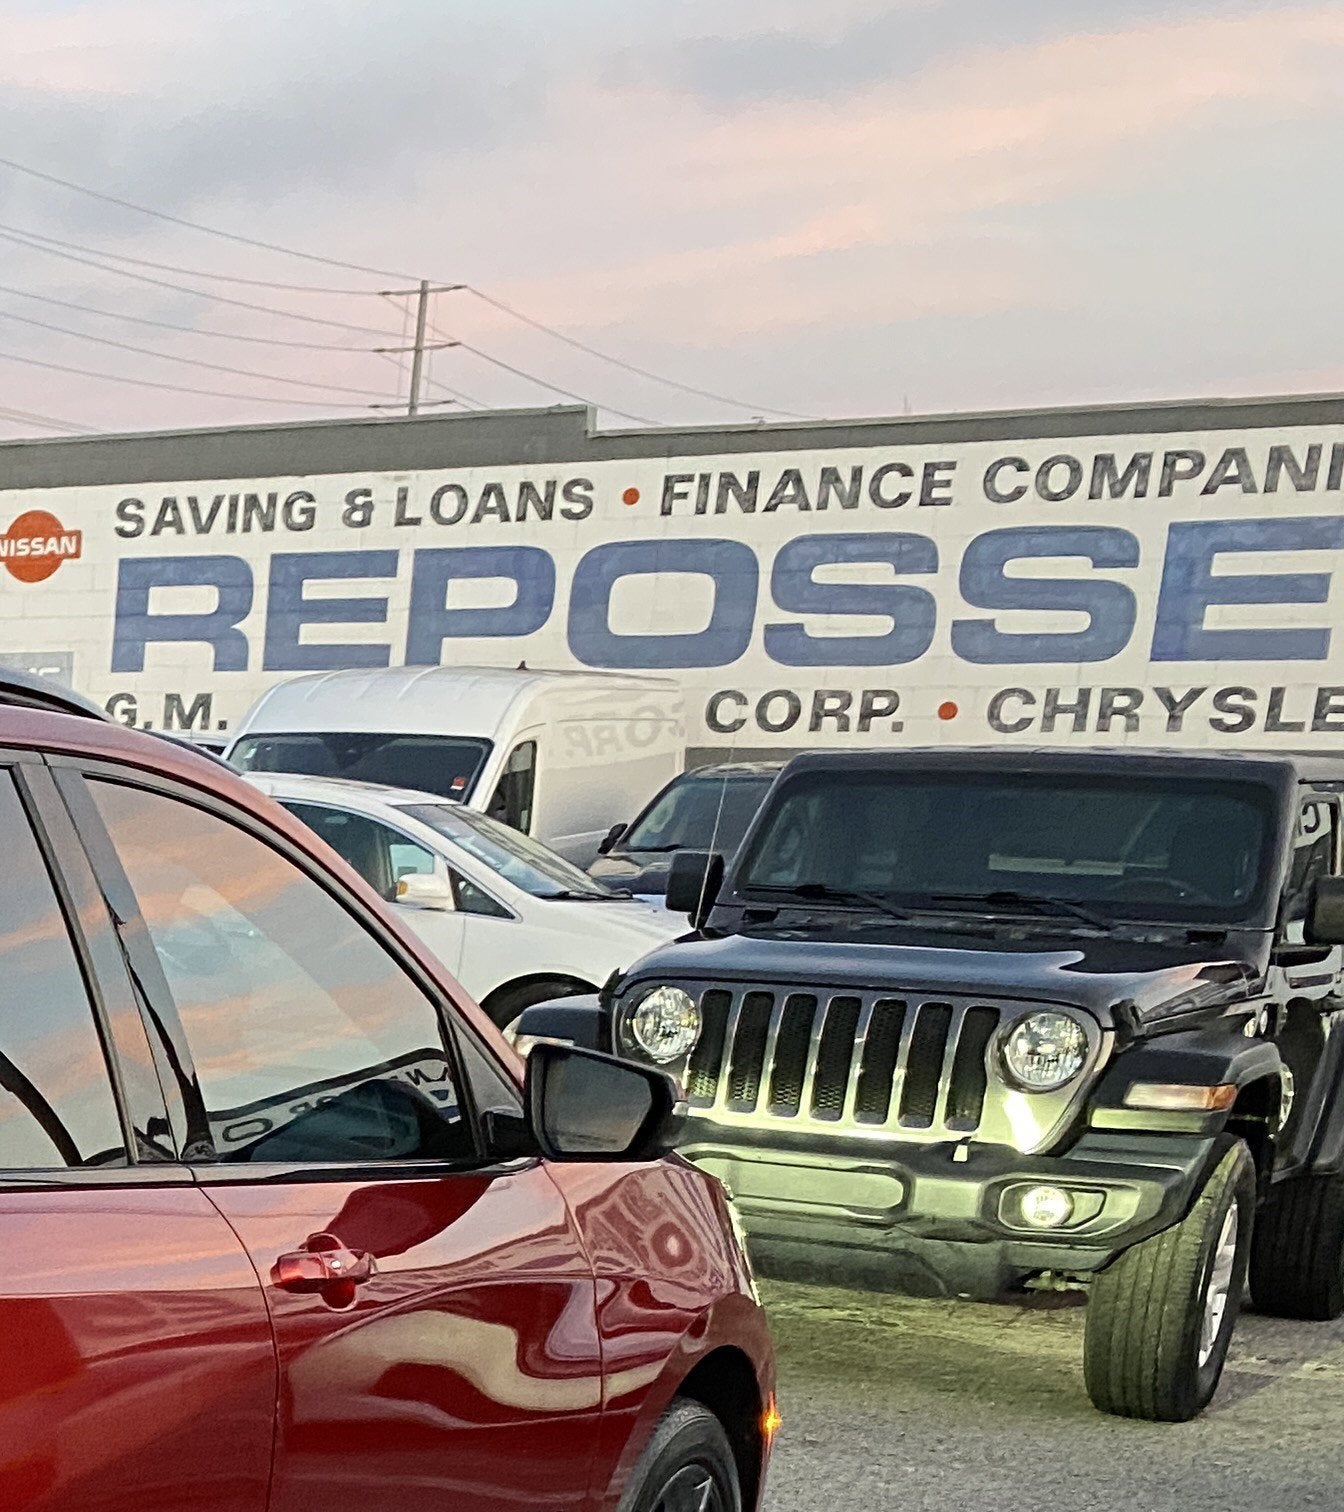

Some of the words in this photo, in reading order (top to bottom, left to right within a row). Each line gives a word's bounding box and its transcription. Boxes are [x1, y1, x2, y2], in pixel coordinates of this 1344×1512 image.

[113, 489, 317, 538] SAVING
[341, 487, 374, 529] &
[394, 477, 595, 527] LOANS
[659, 458, 958, 516] FINANCE
[111, 515, 1344, 673] REPOSSE
[105, 692, 228, 731] G.M.
[706, 687, 905, 734] CORP.
[986, 685, 1344, 734] CHRYSLE
